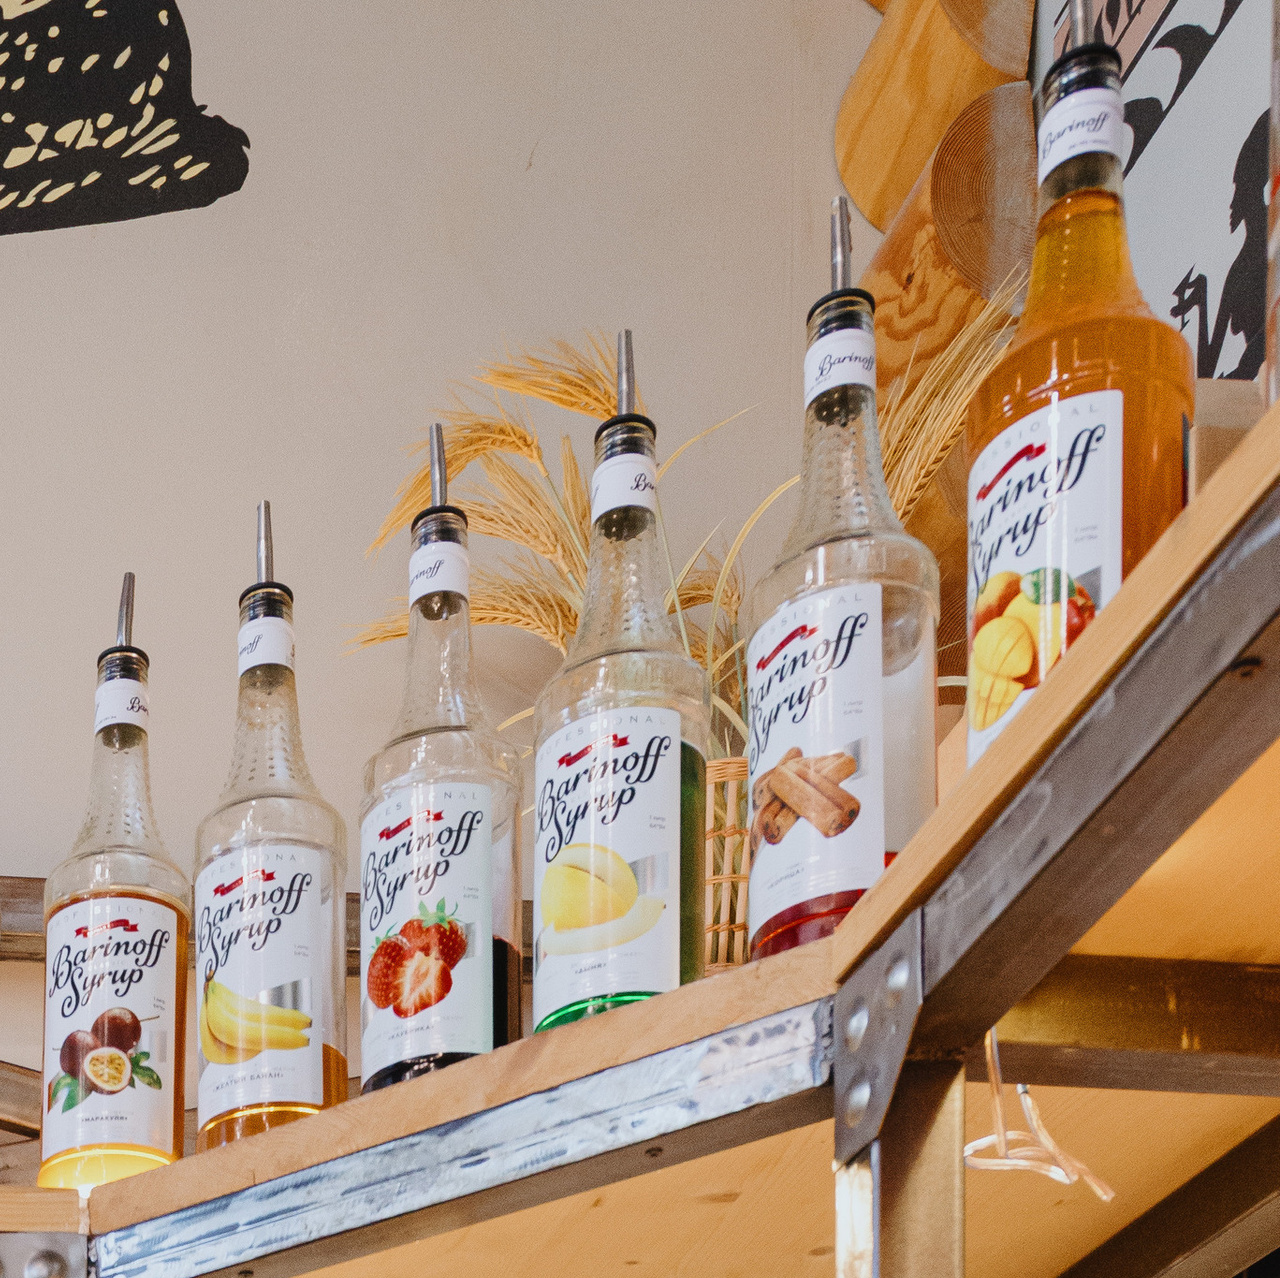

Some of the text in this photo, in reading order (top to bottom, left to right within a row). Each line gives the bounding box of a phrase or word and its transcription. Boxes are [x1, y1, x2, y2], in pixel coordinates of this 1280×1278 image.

[535, 735, 672, 844] Barinoff
[545, 785, 637, 864] Syrup
[360, 810, 484, 912] Barinoff
[369, 857, 450, 932] Syrup
[196, 872, 313, 962] Barinoff
[204, 914, 282, 982] Syrup
[48, 928, 170, 998] Barinoff
[61, 966, 144, 1018] Syrup
